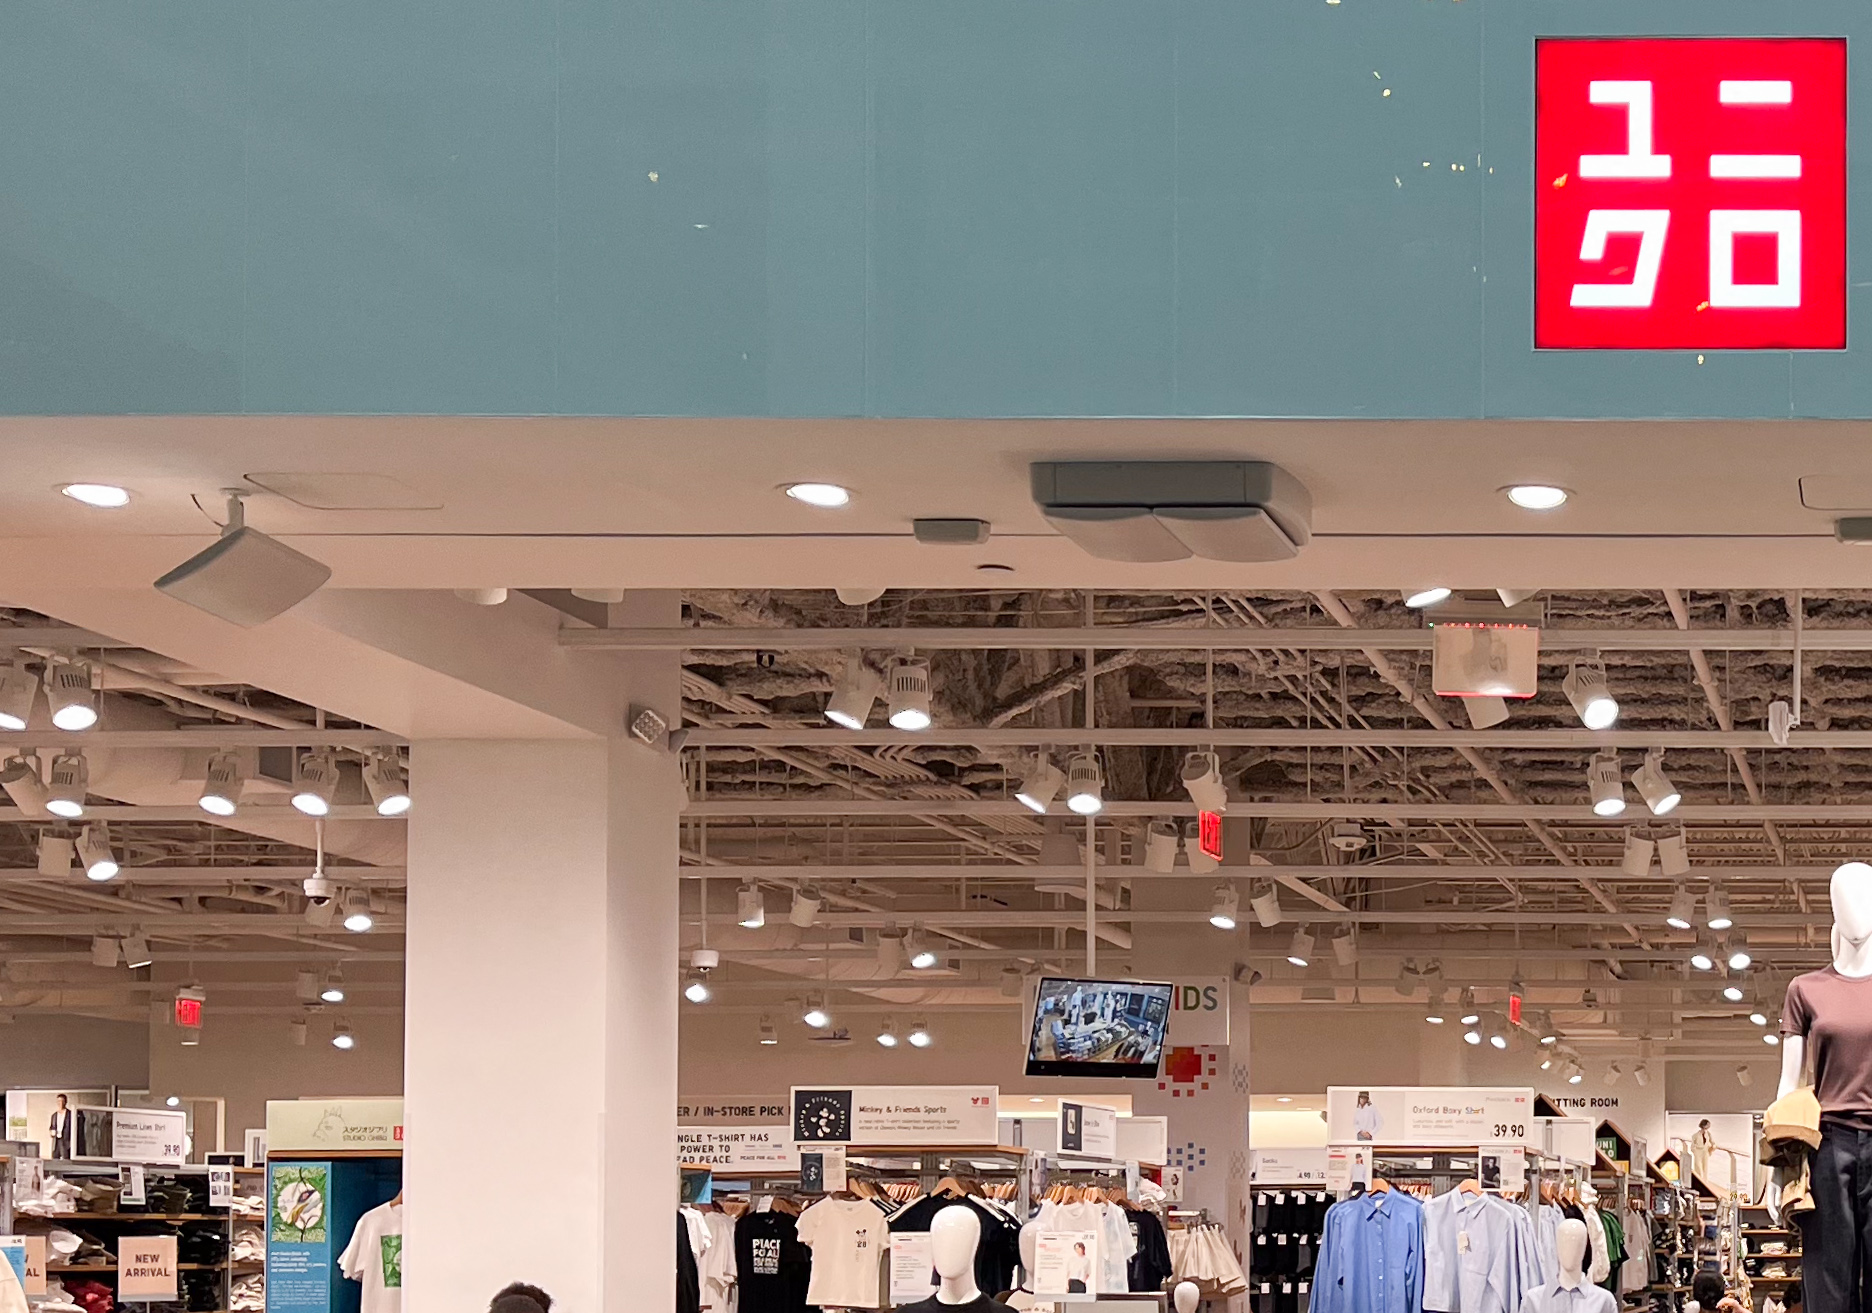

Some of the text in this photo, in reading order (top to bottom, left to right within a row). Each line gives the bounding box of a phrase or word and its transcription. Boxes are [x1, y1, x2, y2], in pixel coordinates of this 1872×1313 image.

[1579, 80, 1801, 178] ユニ
[1570, 209, 1801, 307] クロ
[1590, 1097, 1619, 1108] ROOM
[703, 1106, 755, 1117] IN-STORE
[760, 1106, 784, 1117] PICK
[859, 1106, 947, 1114] Mickey & Friends Sports
[1412, 1106, 1485, 1115] Oxford Boxy Shirt
[707, 1134, 745, 1143] T-SHIRT
[750, 1134, 769, 1143] HAS
[680, 1145, 731, 1153] POWER TO
[135, 1254, 160, 1264] NEW
[125, 1267, 171, 1278] ARRIVAL
